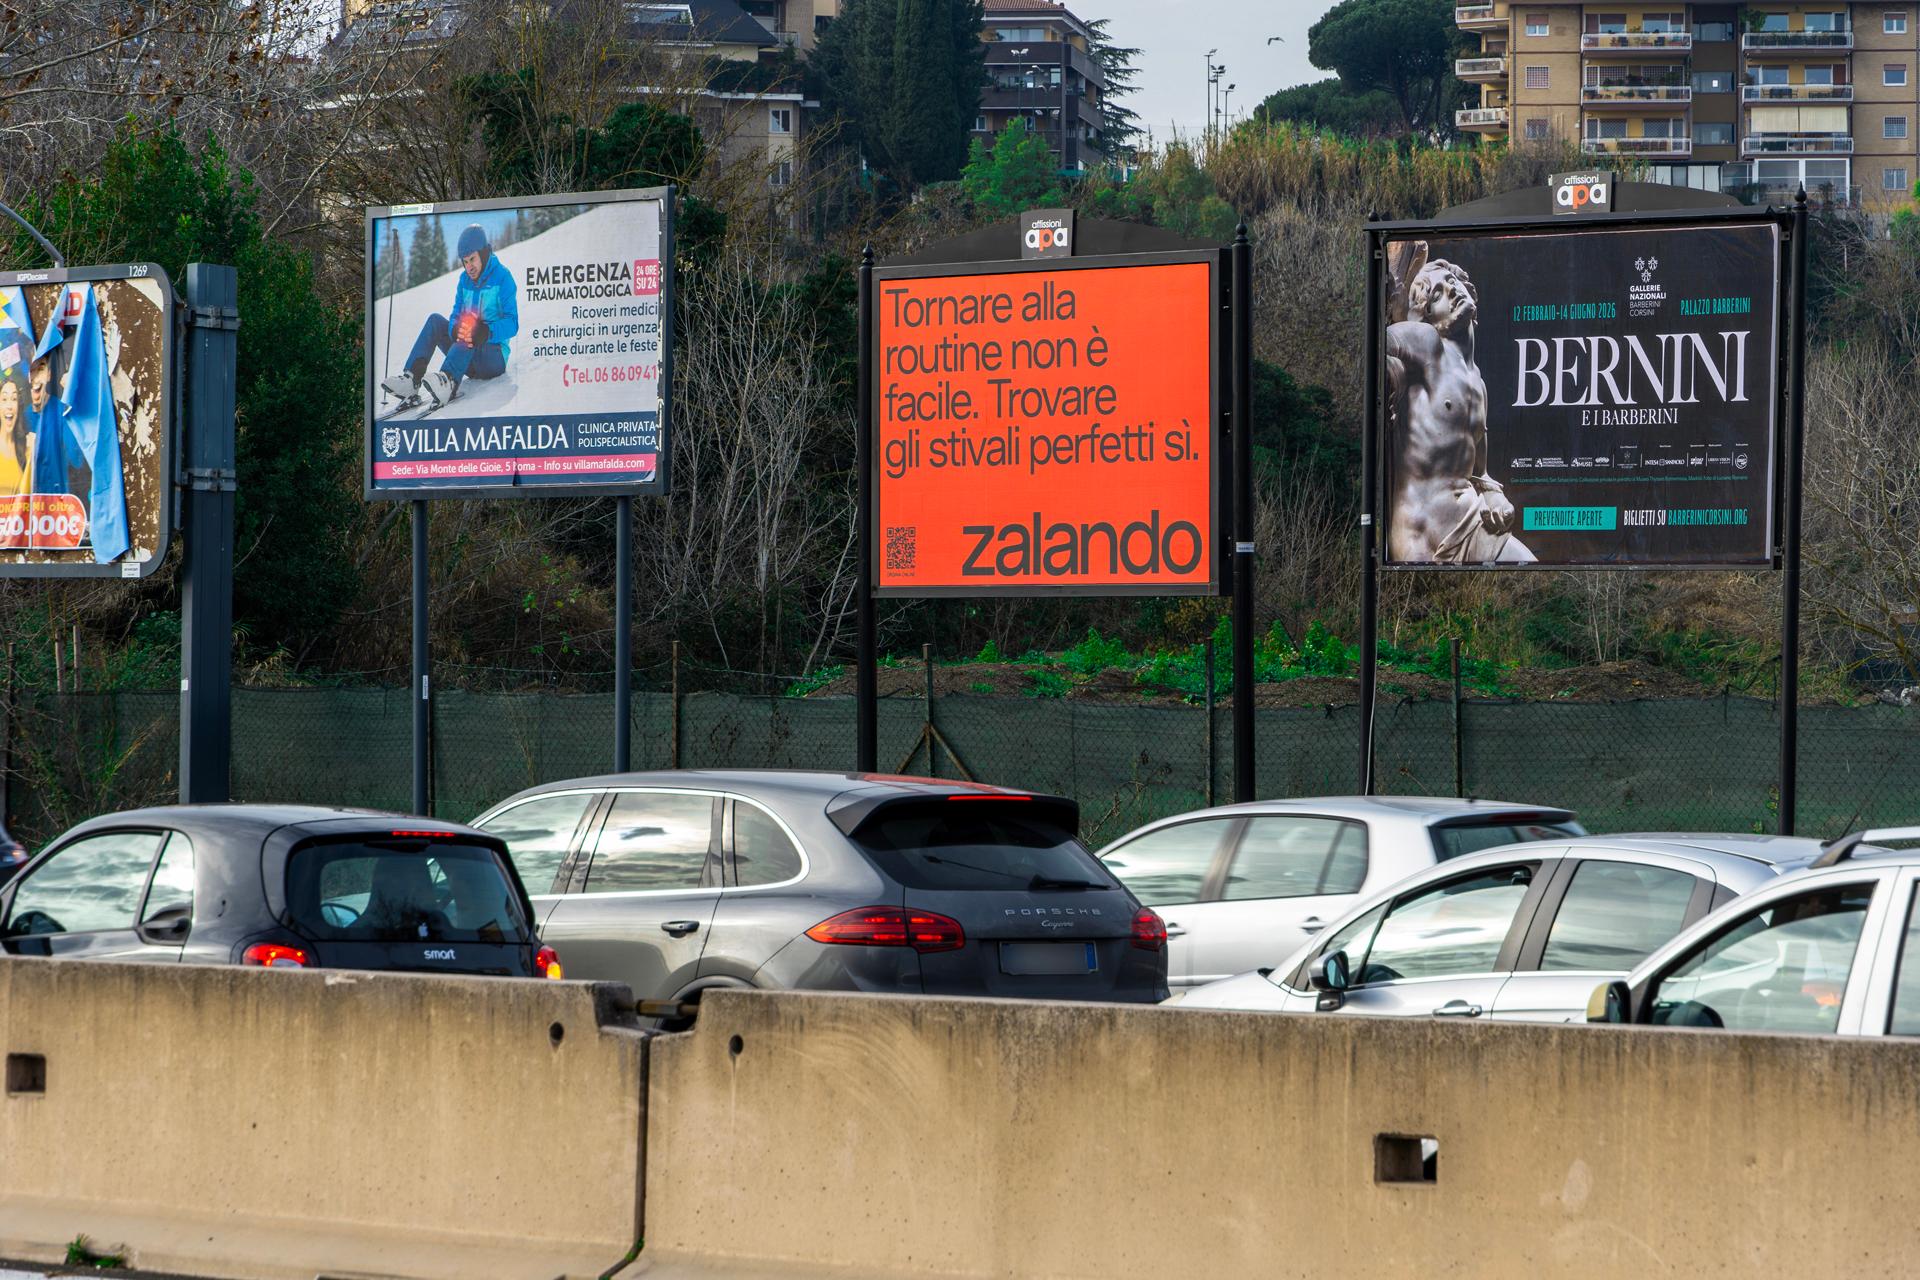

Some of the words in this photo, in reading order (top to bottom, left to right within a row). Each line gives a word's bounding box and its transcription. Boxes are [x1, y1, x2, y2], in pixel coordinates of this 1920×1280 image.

[1564, 173, 1599, 185] affissioni
[1556, 183, 1607, 210] apa
[1031, 218, 1062, 229] affissioni
[1025, 227, 1068, 252] apa
[128, 265, 148, 277] 1269
[526, 262, 632, 286] EMERGENZA
[636, 265, 645, 276] 24
[645, 264, 657, 276] ORE
[636, 277, 647, 290] SU
[647, 276, 657, 289] 24
[1629, 284, 1661, 293] GALLERIE
[526, 283, 632, 302] TRAUMATOLOGICA
[1629, 292, 1667, 301] NAZIONALI
[571, 304, 618, 320] Ricoveri
[620, 302, 658, 317] medici
[884, 287, 1013, 328] Tornare
[1020, 280, 1077, 323] alla
[1513, 305, 1521, 322] 12
[1570, 303, 1596, 320] GIUGNO
[1598, 302, 1616, 319] 2026
[1629, 300, 1661, 309] BARBERINI
[1629, 308, 1655, 317] CORSINI
[1680, 298, 1711, 316] PALAZZO
[1712, 297, 1751, 314] BARBERINI
[532, 329, 540, 340] e
[542, 323, 595, 341] chirurgici
[598, 322, 609, 337] in
[611, 323, 658, 338] urgenza
[533, 343, 568, 358] anche
[570, 341, 615, 356] durante
[617, 339, 628, 353] le
[630, 338, 658, 352] feste
[886, 332, 1003, 375] routine
[1011, 336, 1077, 370] non
[1086, 325, 1109, 367] è
[570, 367, 593, 384] Tel.
[594, 367, 609, 383] 06
[611, 366, 626, 381] 86
[1511, 331, 1751, 407] BERNINI
[884, 380, 979, 422] facile.
[987, 378, 1117, 419] Trovare
[1581, 409, 1591, 427] E
[1593, 409, 1599, 426] I
[1601, 408, 1679, 427] BARBERINI
[577, 422, 615, 435] CLINICA
[617, 420, 657, 433] PRIVATA
[402, 427, 460, 455] VILLA
[463, 423, 570, 452] MAFALDA
[578, 435, 657, 449] POLISPECIALISTICA
[885, 428, 921, 480] gli
[928, 426, 1021, 468] stivali
[1029, 422, 1155, 476] perfetti
[1163, 418, 1200, 461] sì.
[392, 464, 414, 476] Sede:
[415, 464, 429, 475] Via
[433, 463, 457, 474] Monte
[458, 462, 478, 474] delle
[479, 461, 504, 474] Gioie,
[505, 461, 511, 472] 5
[543, 460, 560, 471] Info
[562, 461, 573, 470] su
[573, 458, 645, 470] villamafalda.com
[48, 501, 76, 513] oltre
[1534, 509, 1575, 527] PREVENDITE
[1576, 510, 1603, 526] APERTE
[1623, 509, 1656, 526] BIGLIETTI
[1656, 509, 1667, 526] SU
[1667, 508, 1748, 526] BARBERINICORSINI.ORG
[961, 509, 1203, 577] zalando
[1004, 907, 1102, 917] PORSCHE
[1041, 919, 1075, 931] Cayenne
[423, 948, 457, 960] smart
